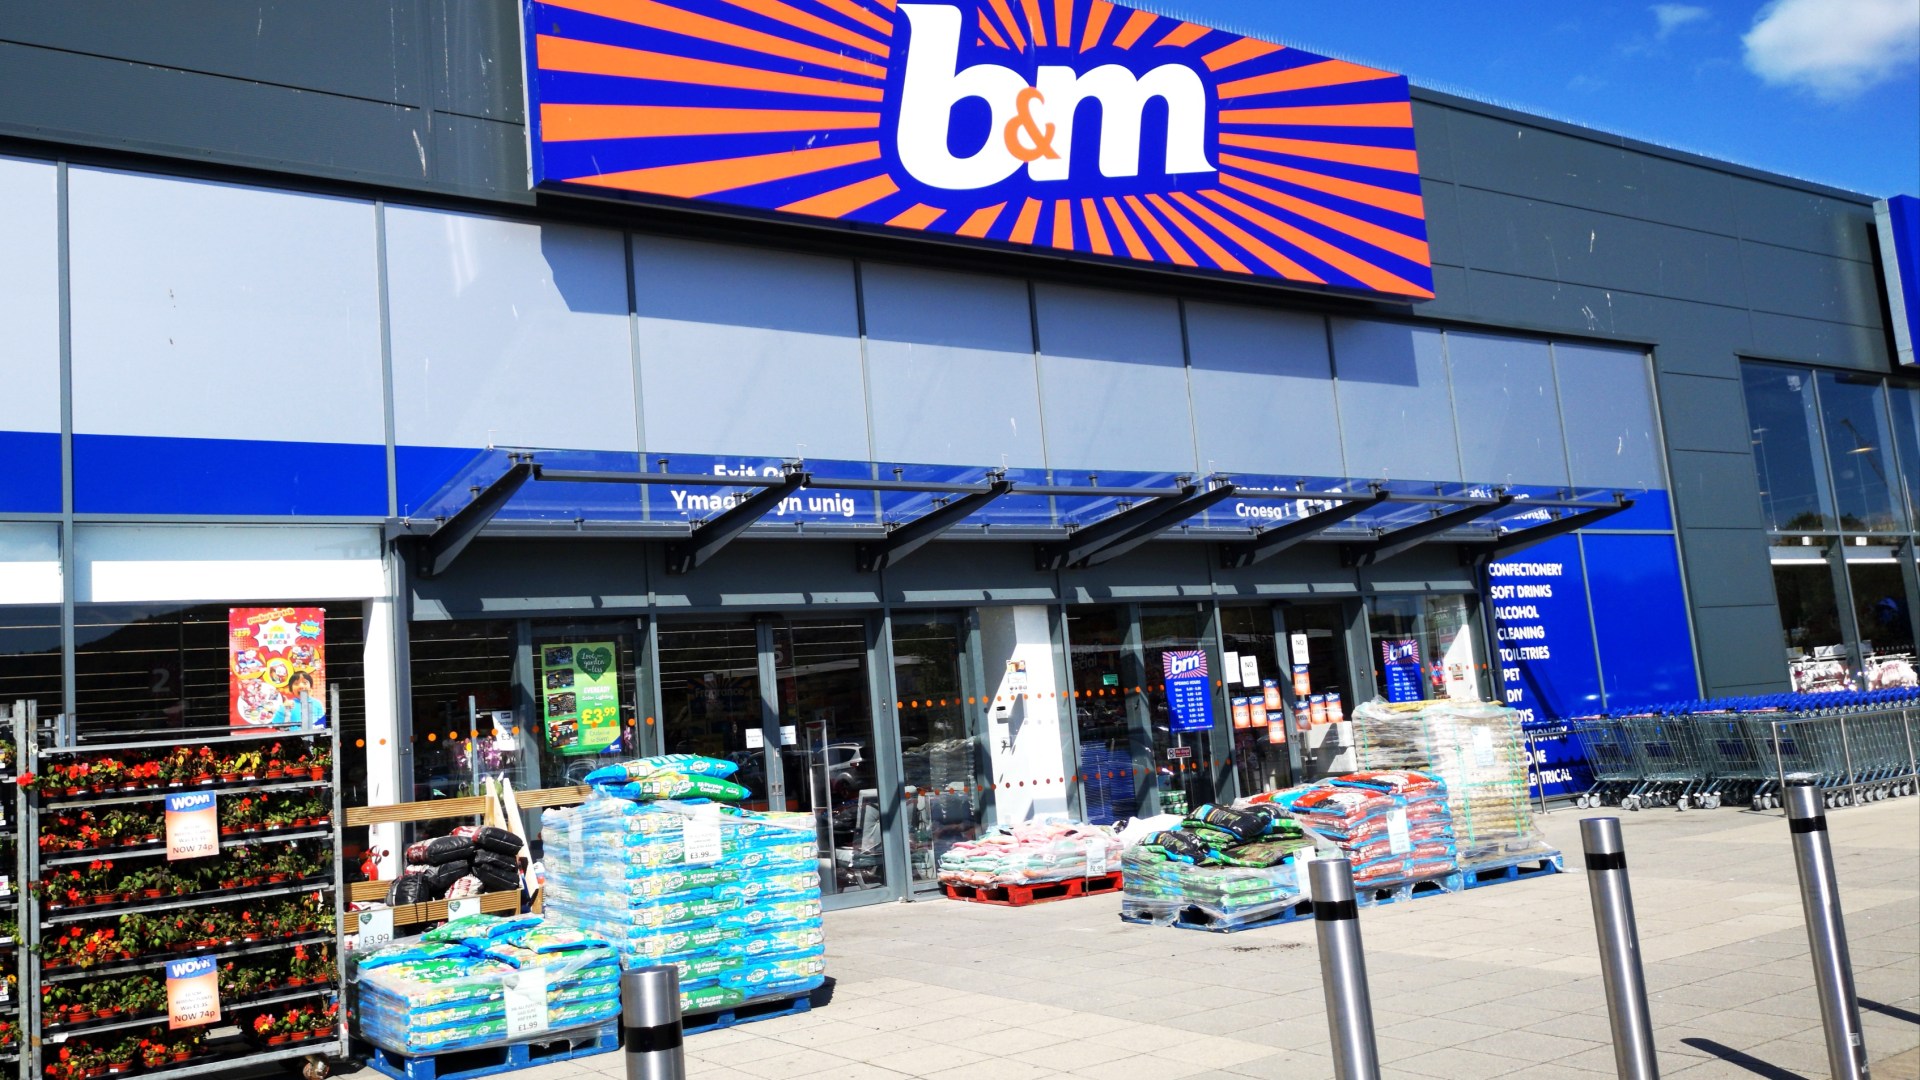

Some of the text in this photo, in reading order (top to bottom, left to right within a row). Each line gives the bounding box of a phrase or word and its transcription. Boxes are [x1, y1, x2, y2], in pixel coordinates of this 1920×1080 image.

[897, 3, 1217, 190] b&m
[671, 490, 855, 517] Ymad yn unig
[1285, 503, 1290, 516] i
[1488, 563, 1563, 576] CONFECTIONERY
[1490, 584, 1552, 599] SOFT DRINKS
[1495, 605, 1540, 619] ALCOHOL
[1497, 625, 1545, 641] CLEANING
[1499, 646, 1550, 661] TOILETRIES
[152, 668, 171, 693] 2
[1503, 668, 1520, 681] PET
[1506, 688, 1523, 702] DIY
[581, 706, 616, 725] £3.99
[1516, 708, 1534, 722] OYS
[1524, 725, 1568, 743] ATIONERY
[173, 845, 195, 854] NOW
[690, 851, 709, 860] £3.99
[364, 933, 389, 946] £3.99
[174, 1010, 215, 1022] NOW 74p
[518, 1021, 538, 1031] £1.99
